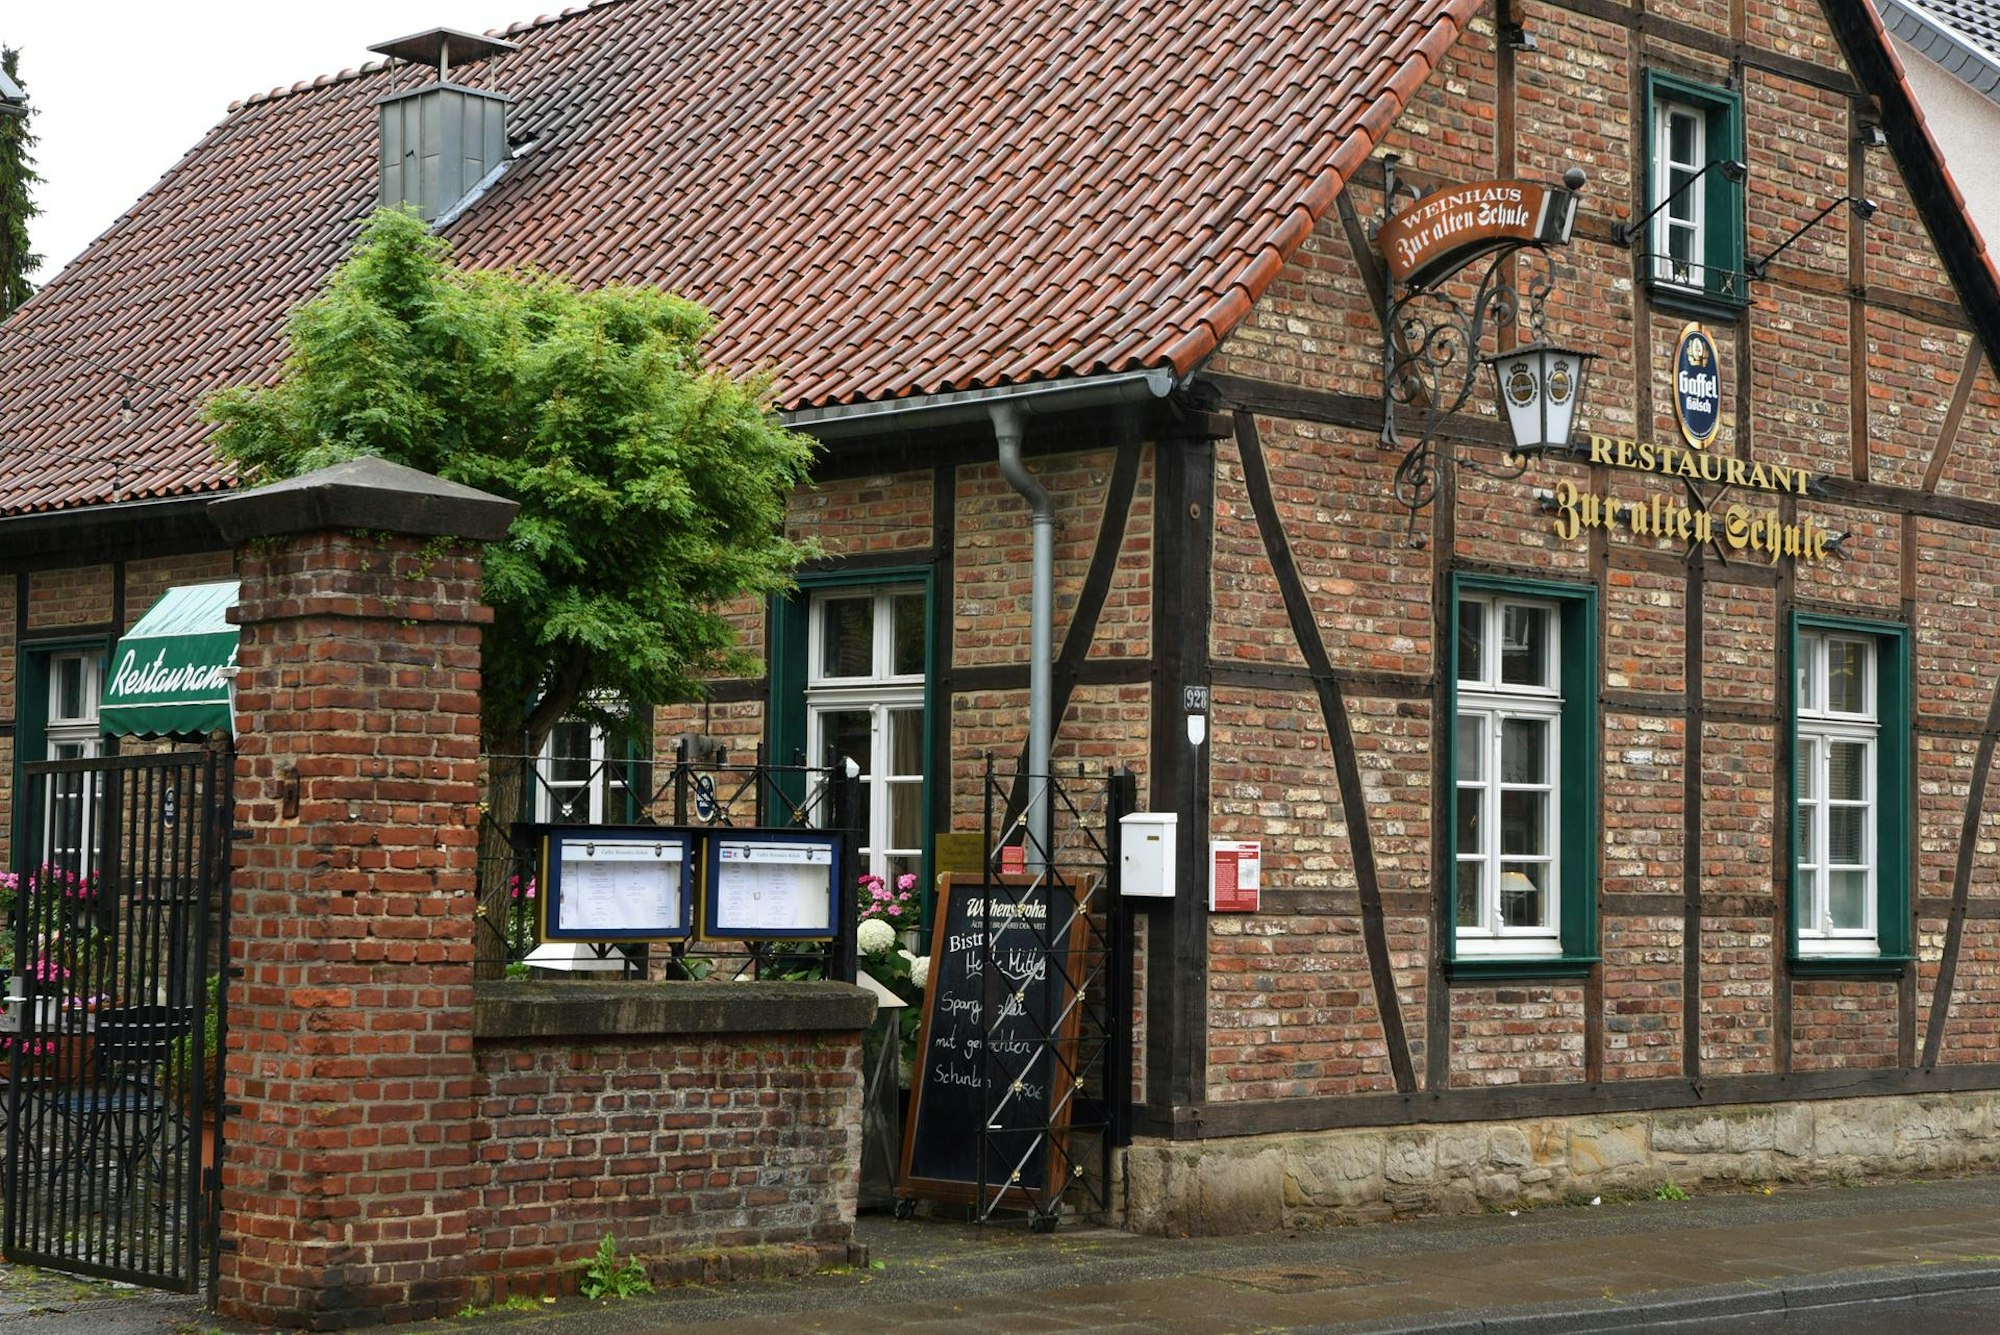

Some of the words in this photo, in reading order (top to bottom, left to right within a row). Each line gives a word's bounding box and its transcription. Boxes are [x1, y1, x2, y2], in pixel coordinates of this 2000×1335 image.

[1401, 187, 1522, 230] WEINHAUS
[1395, 230, 1430, 268] Zur
[1433, 209, 1474, 242] alten
[1477, 202, 1529, 229] Schule
[1679, 369, 1718, 399] Gaffel
[1686, 395, 1712, 414] Kölsch
[1589, 435, 1812, 495] RESTAURANT
[1553, 478, 1623, 541] Zur
[1631, 493, 1713, 544] alten
[1725, 503, 1829, 565] Schule
[109, 642, 240, 697] Restaurant
[1186, 689, 1207, 709] 928
[950, 932, 993, 953] Bistr
